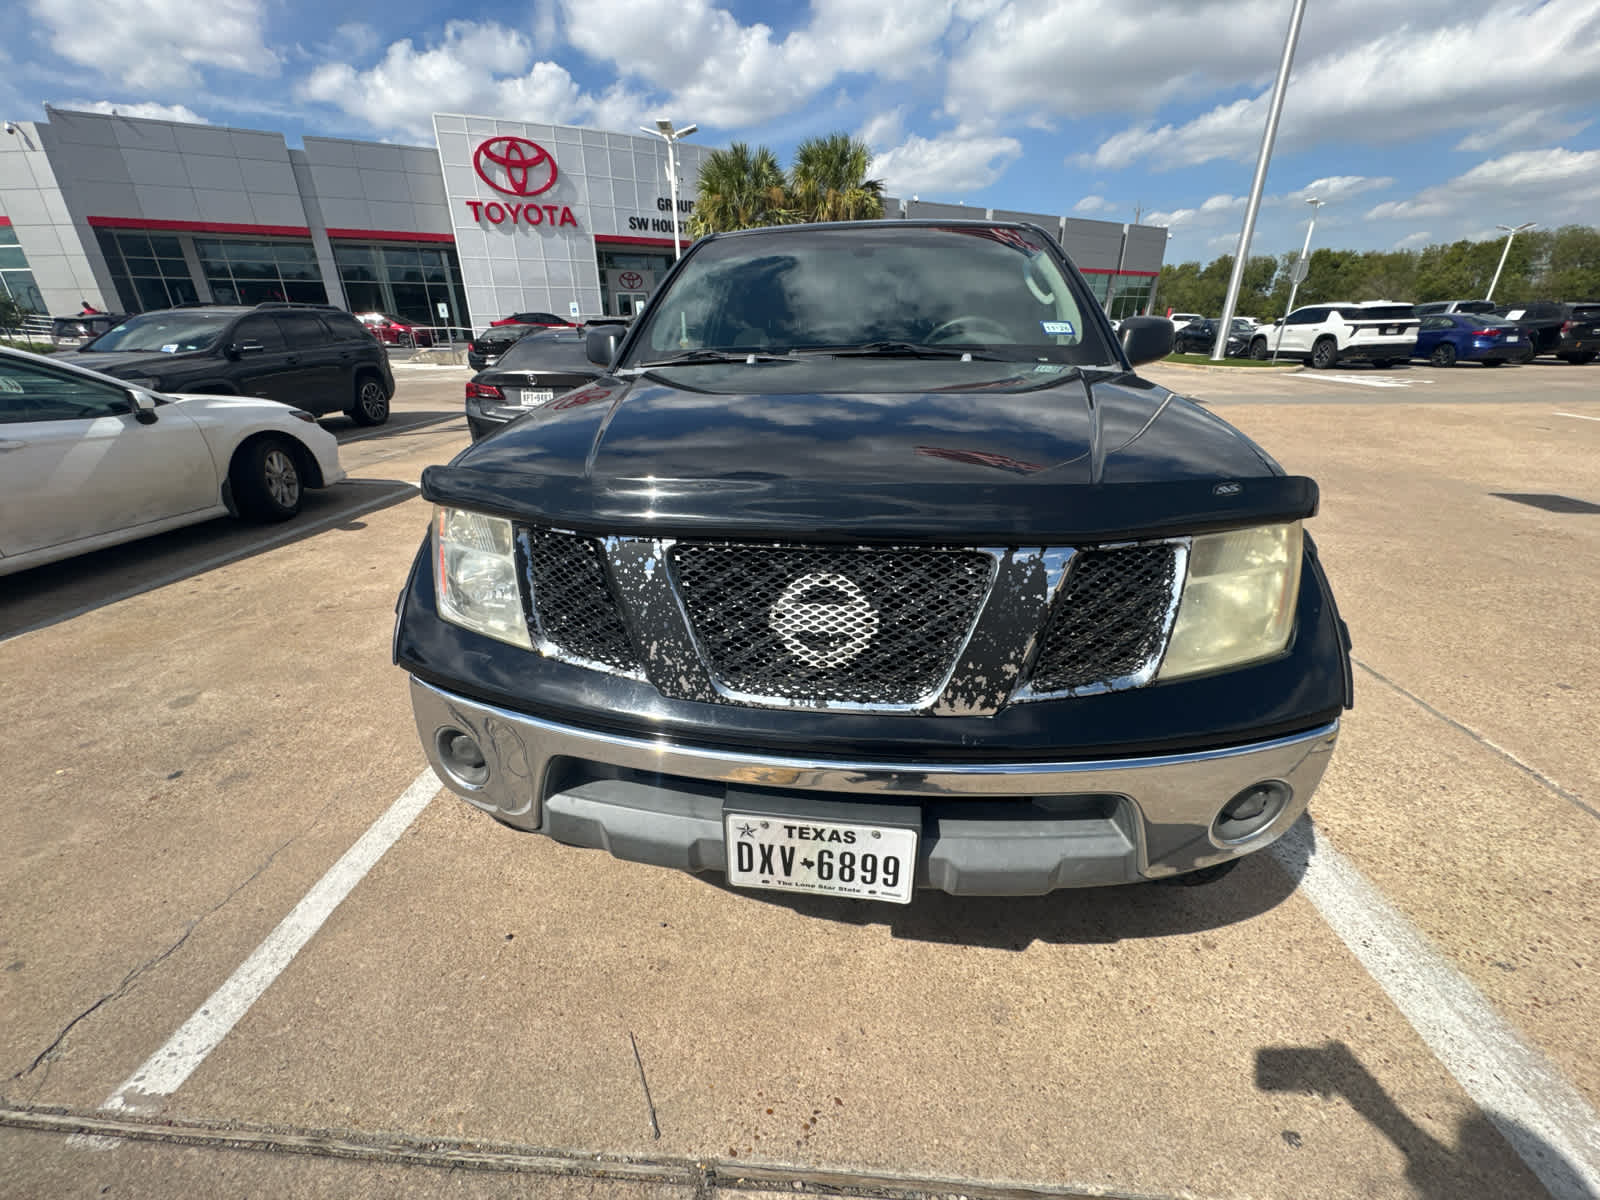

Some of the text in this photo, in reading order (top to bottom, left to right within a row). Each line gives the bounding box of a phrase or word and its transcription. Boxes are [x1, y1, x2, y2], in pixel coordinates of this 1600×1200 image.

[466, 201, 578, 227] TOYOTA
[628, 216, 649, 231] SW
[784, 825, 857, 844] TEXAS
[737, 841, 900, 888] DXV 6899
[818, 883, 836, 891] Star
